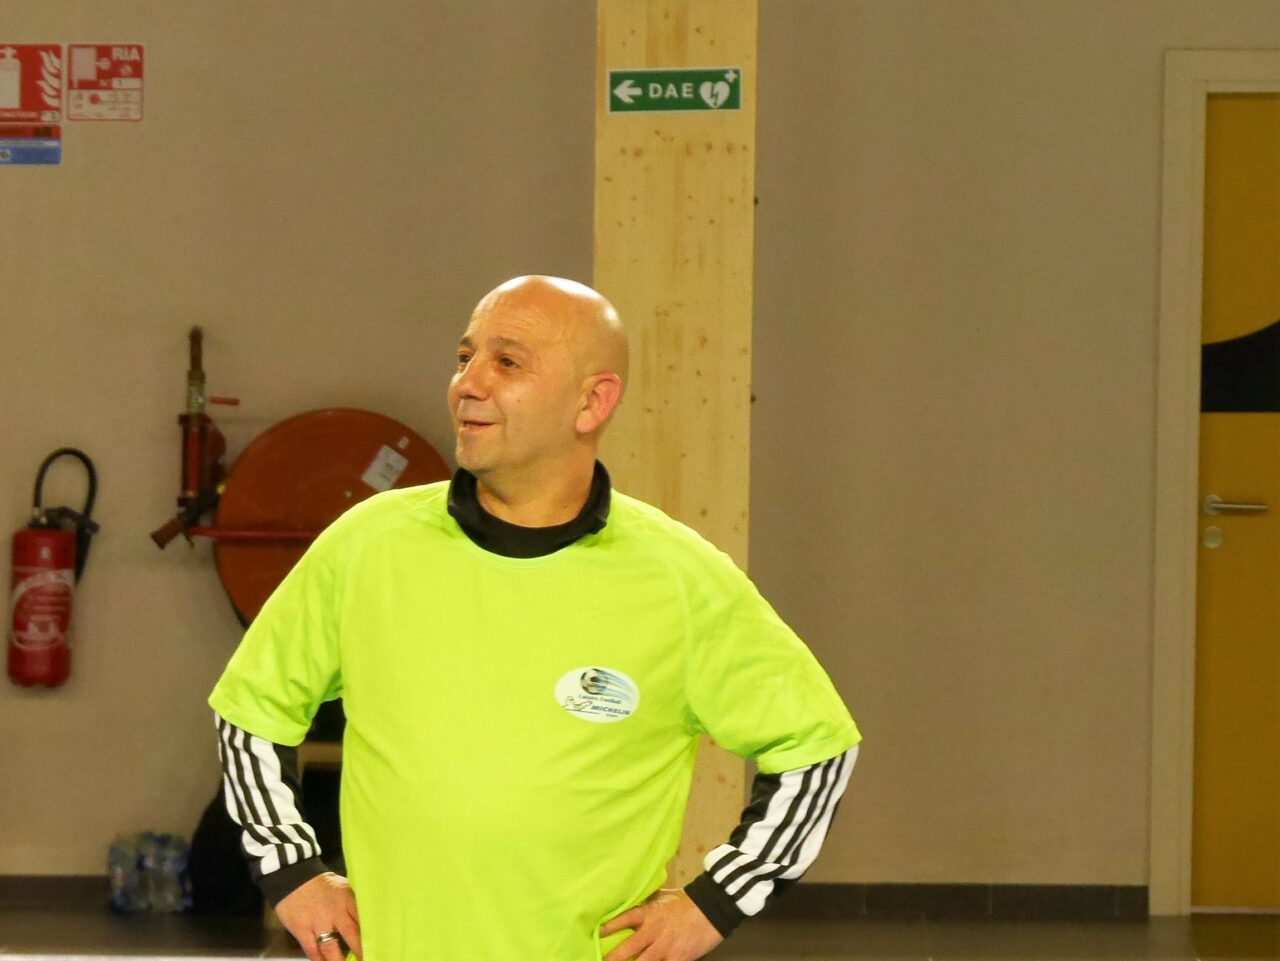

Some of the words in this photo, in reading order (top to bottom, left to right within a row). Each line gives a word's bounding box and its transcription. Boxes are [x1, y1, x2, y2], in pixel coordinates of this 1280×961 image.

[111, 47, 140, 61] RIA
[648, 83, 695, 99] DAE
[590, 705, 631, 716] MICHELIN
